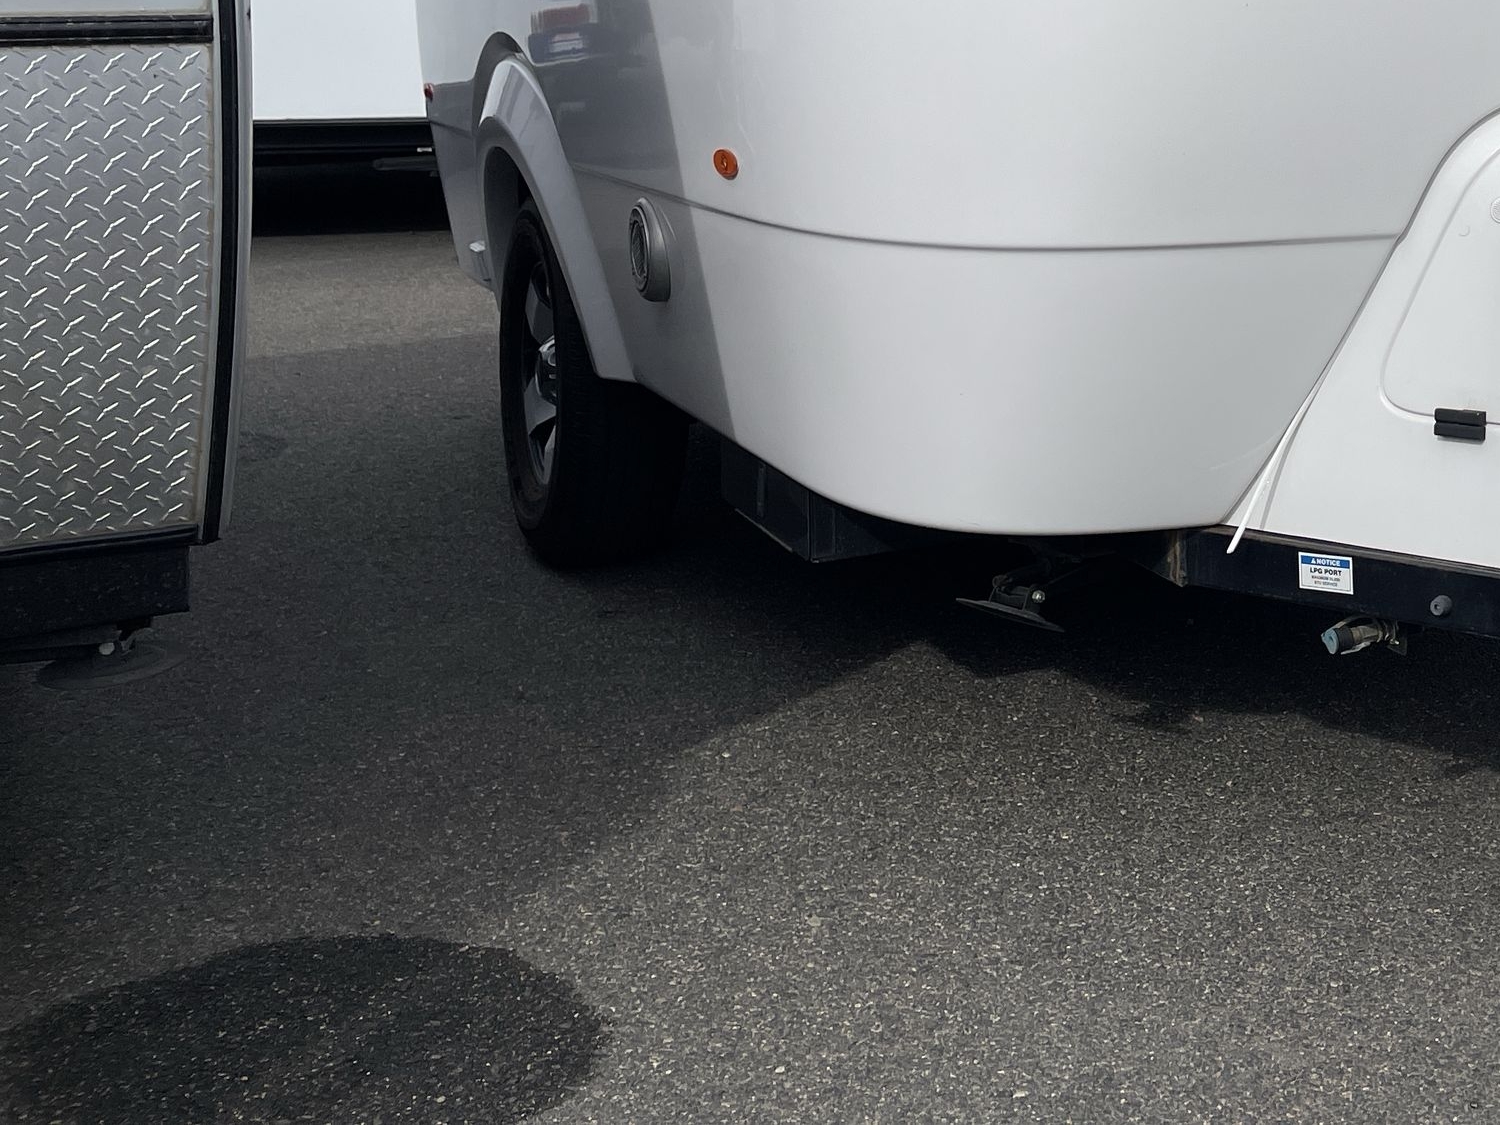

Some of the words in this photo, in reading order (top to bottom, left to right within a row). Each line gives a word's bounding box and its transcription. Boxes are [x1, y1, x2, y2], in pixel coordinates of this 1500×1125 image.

[1316, 558, 1341, 567] NOTICE
[1310, 567, 1323, 575] LPG
[1324, 568, 1342, 576] PORT
